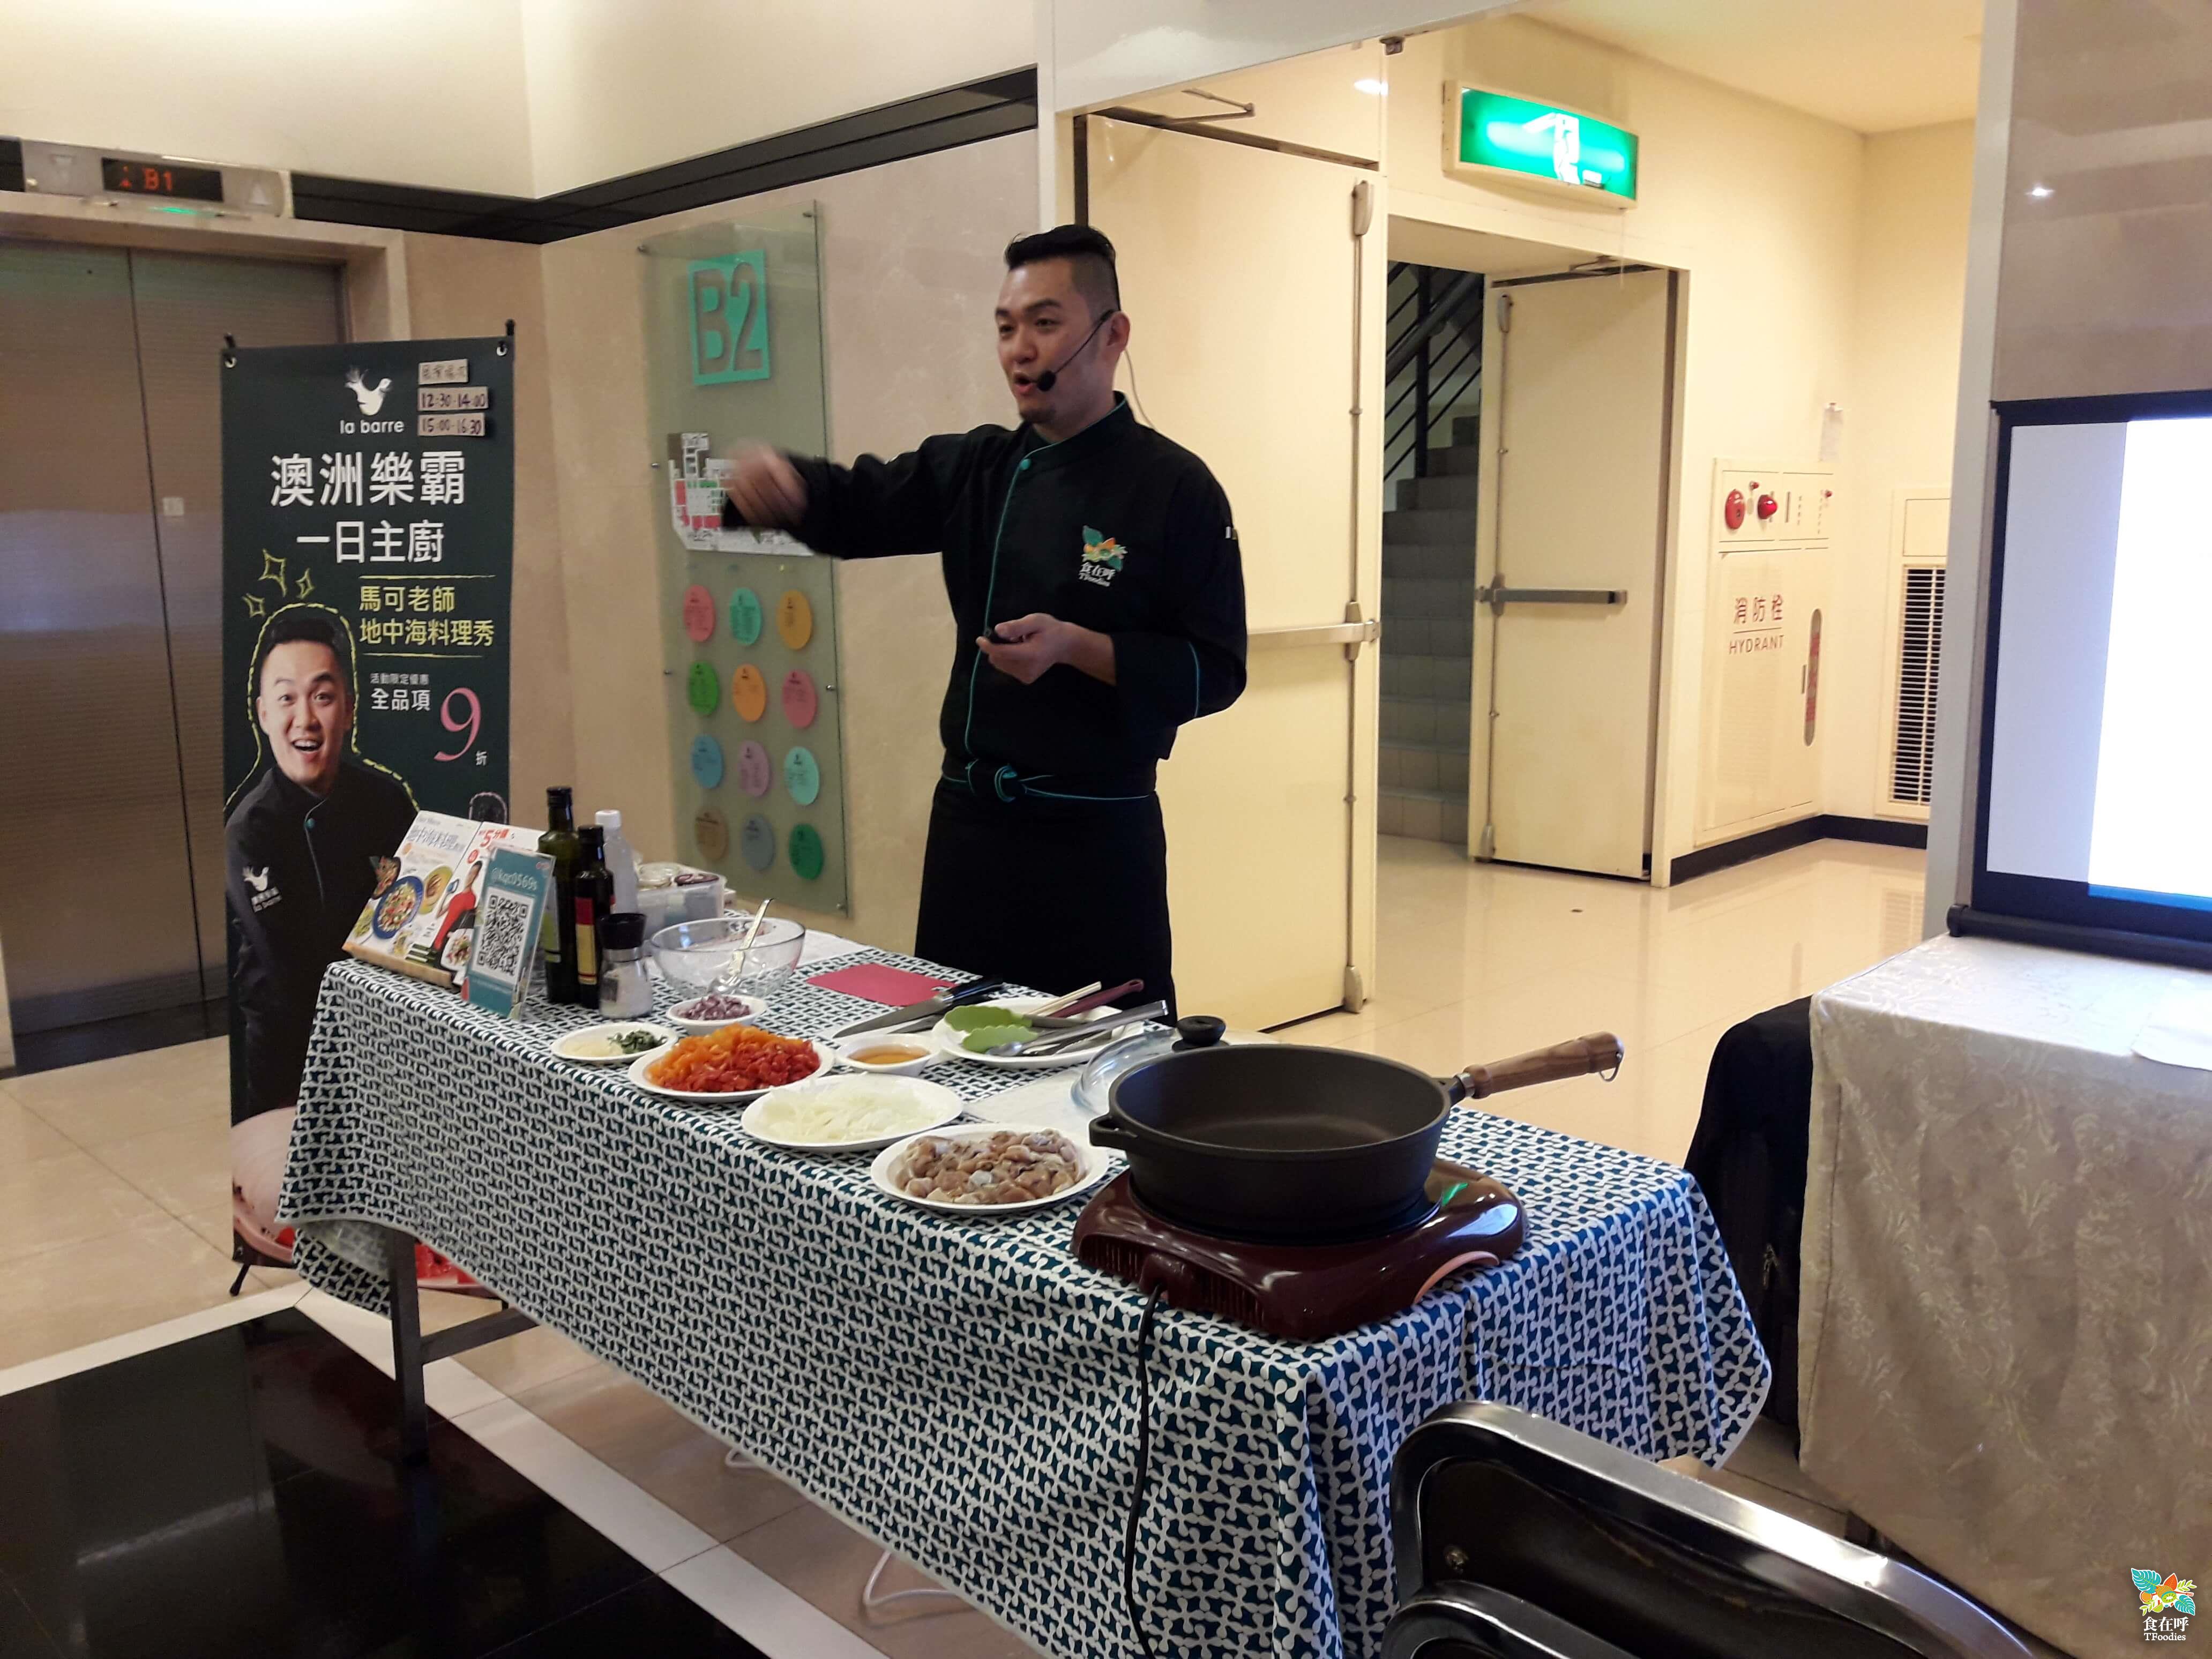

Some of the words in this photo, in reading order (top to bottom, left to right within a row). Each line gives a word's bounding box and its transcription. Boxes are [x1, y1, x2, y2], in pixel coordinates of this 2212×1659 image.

[144, 167, 173, 192] B1
[694, 261, 764, 375] B2
[340, 420, 355, 434] la
[360, 420, 404, 434] barre
[270, 451, 465, 507] 澳洲樂霸
[296, 519, 445, 564] 一日主廚
[359, 585, 455, 612] 馬可老師
[1733, 594, 1783, 624] 消防栓
[359, 618, 494, 646] 地中海料理秀
[1729, 634, 1784, 655] HYDRANT
[371, 687, 431, 711] 全品項
[434, 687, 481, 761] 9
